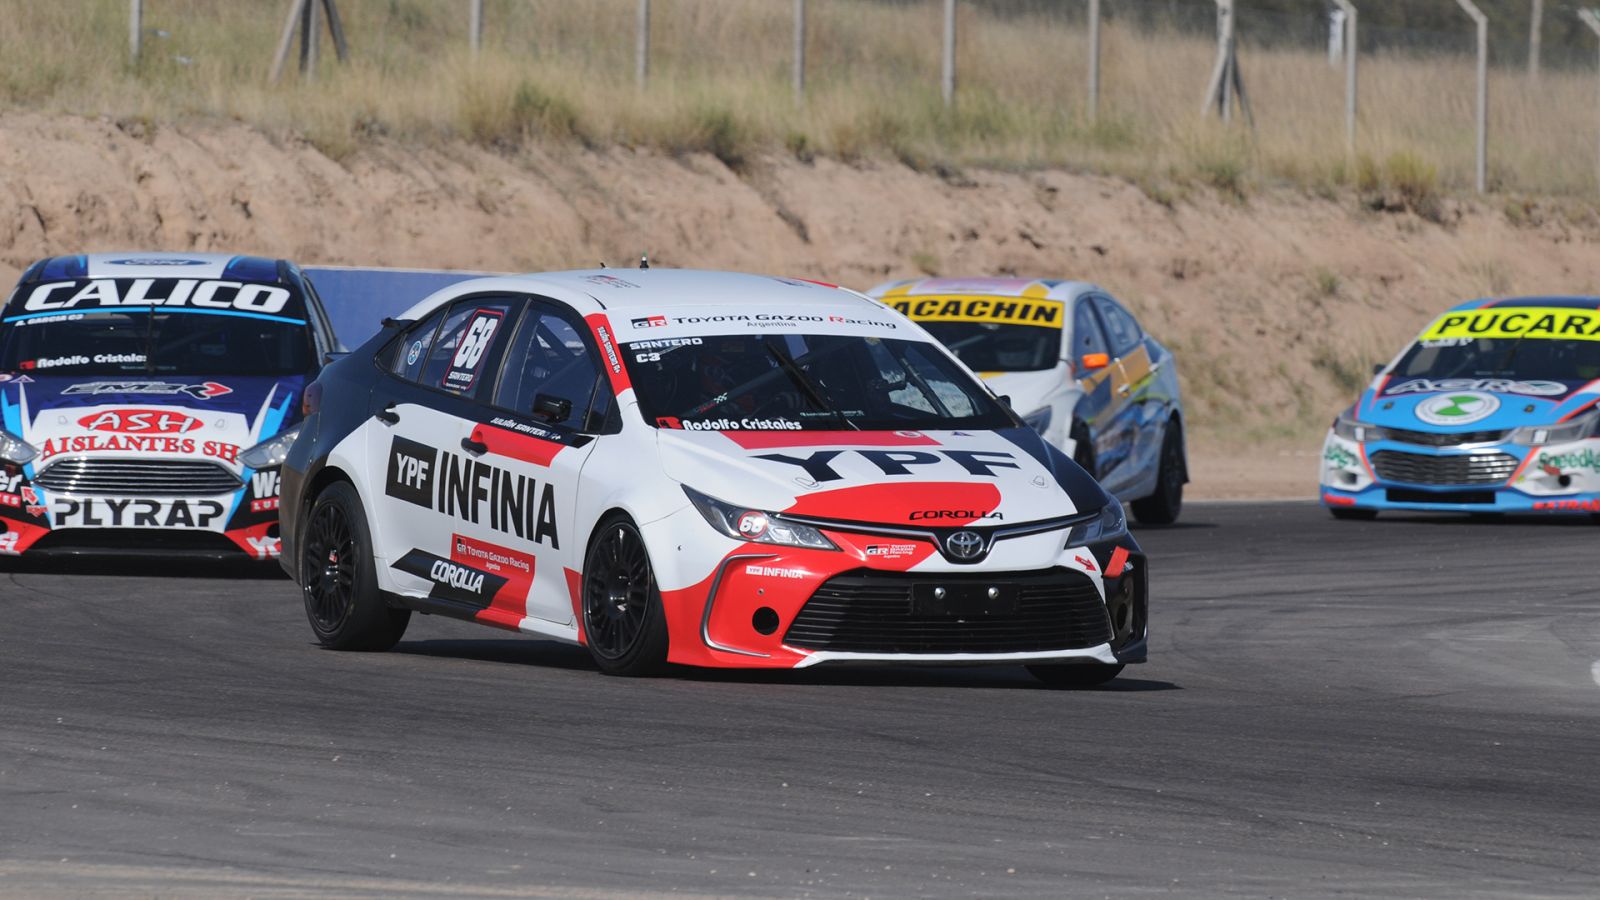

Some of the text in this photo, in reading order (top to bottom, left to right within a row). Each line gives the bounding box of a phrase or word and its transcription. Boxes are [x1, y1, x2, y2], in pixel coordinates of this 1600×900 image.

[25, 279, 290, 313] CALICO
[633, 313, 897, 329] GR TOYOTA GAZOO Racing
[894, 300, 1057, 322] ACACHIN
[747, 321, 797, 329] Argentina
[454, 316, 498, 369] 68
[629, 337, 703, 350] SANTERO
[37, 355, 90, 368] Rodolfo
[636, 352, 661, 363] C3
[89, 411, 196, 434] ASH
[682, 418, 802, 431] Rodolfo Cristales
[42, 434, 241, 464] AISLANTES SH
[745, 449, 1021, 482] YPF
[396, 450, 560, 551] YPF INFINIA
[55, 499, 224, 527] PLYRAP
[909, 510, 1004, 520] COROLLA
[509, 557, 530, 573] Racing
[430, 559, 485, 595] COROLLA
